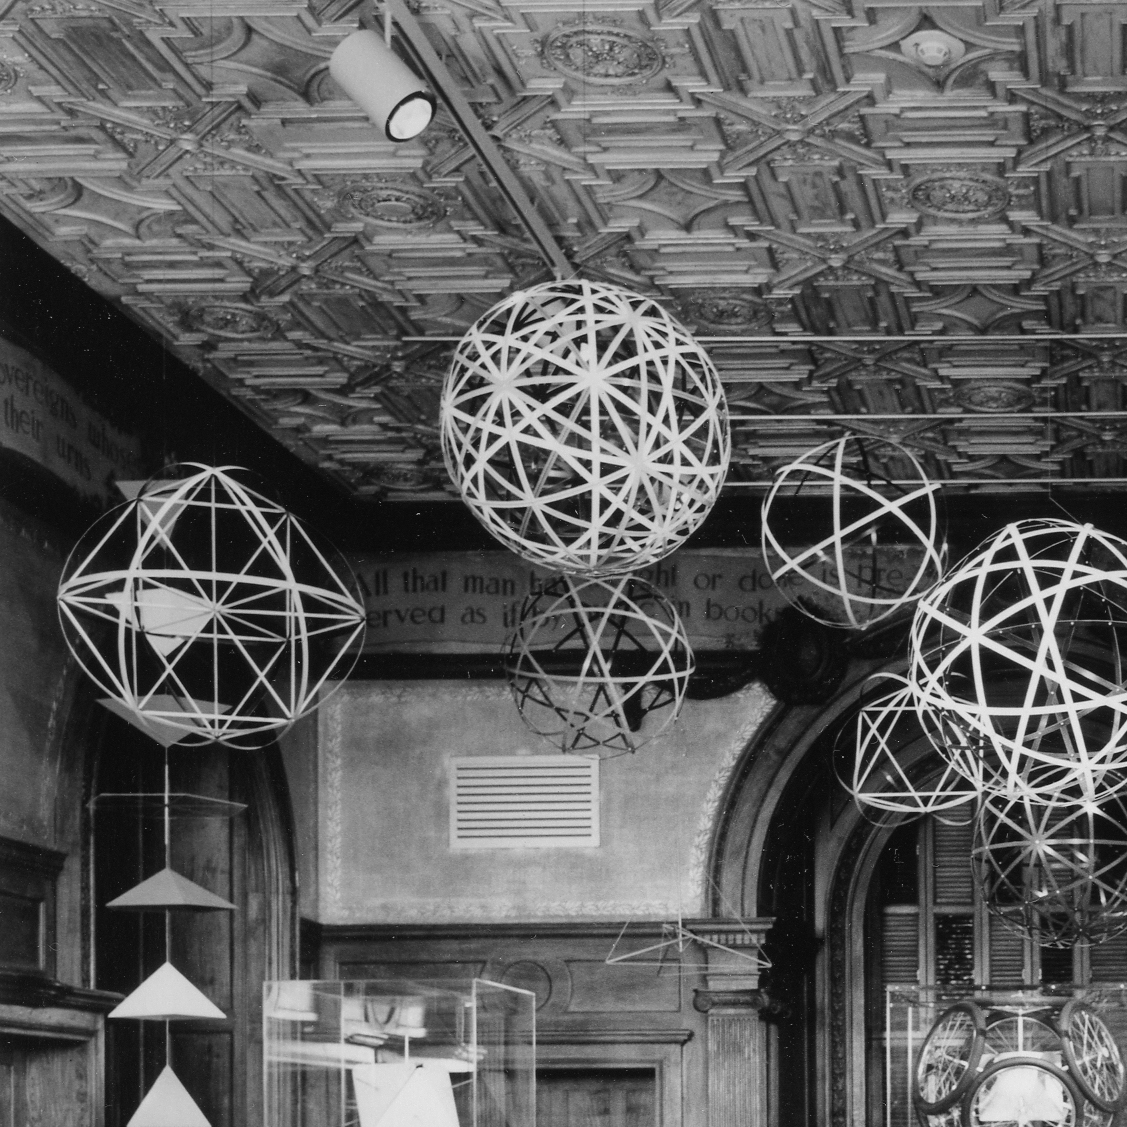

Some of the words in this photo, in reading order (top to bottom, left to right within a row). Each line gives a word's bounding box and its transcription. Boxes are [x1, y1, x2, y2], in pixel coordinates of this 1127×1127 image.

[4, 394, 43, 443] their
[349, 568, 389, 597] All
[403, 567, 448, 594] that
[463, 574, 516, 596] man
[693, 573, 723, 591] or
[363, 604, 446, 629] erved
[460, 605, 487, 625] as
